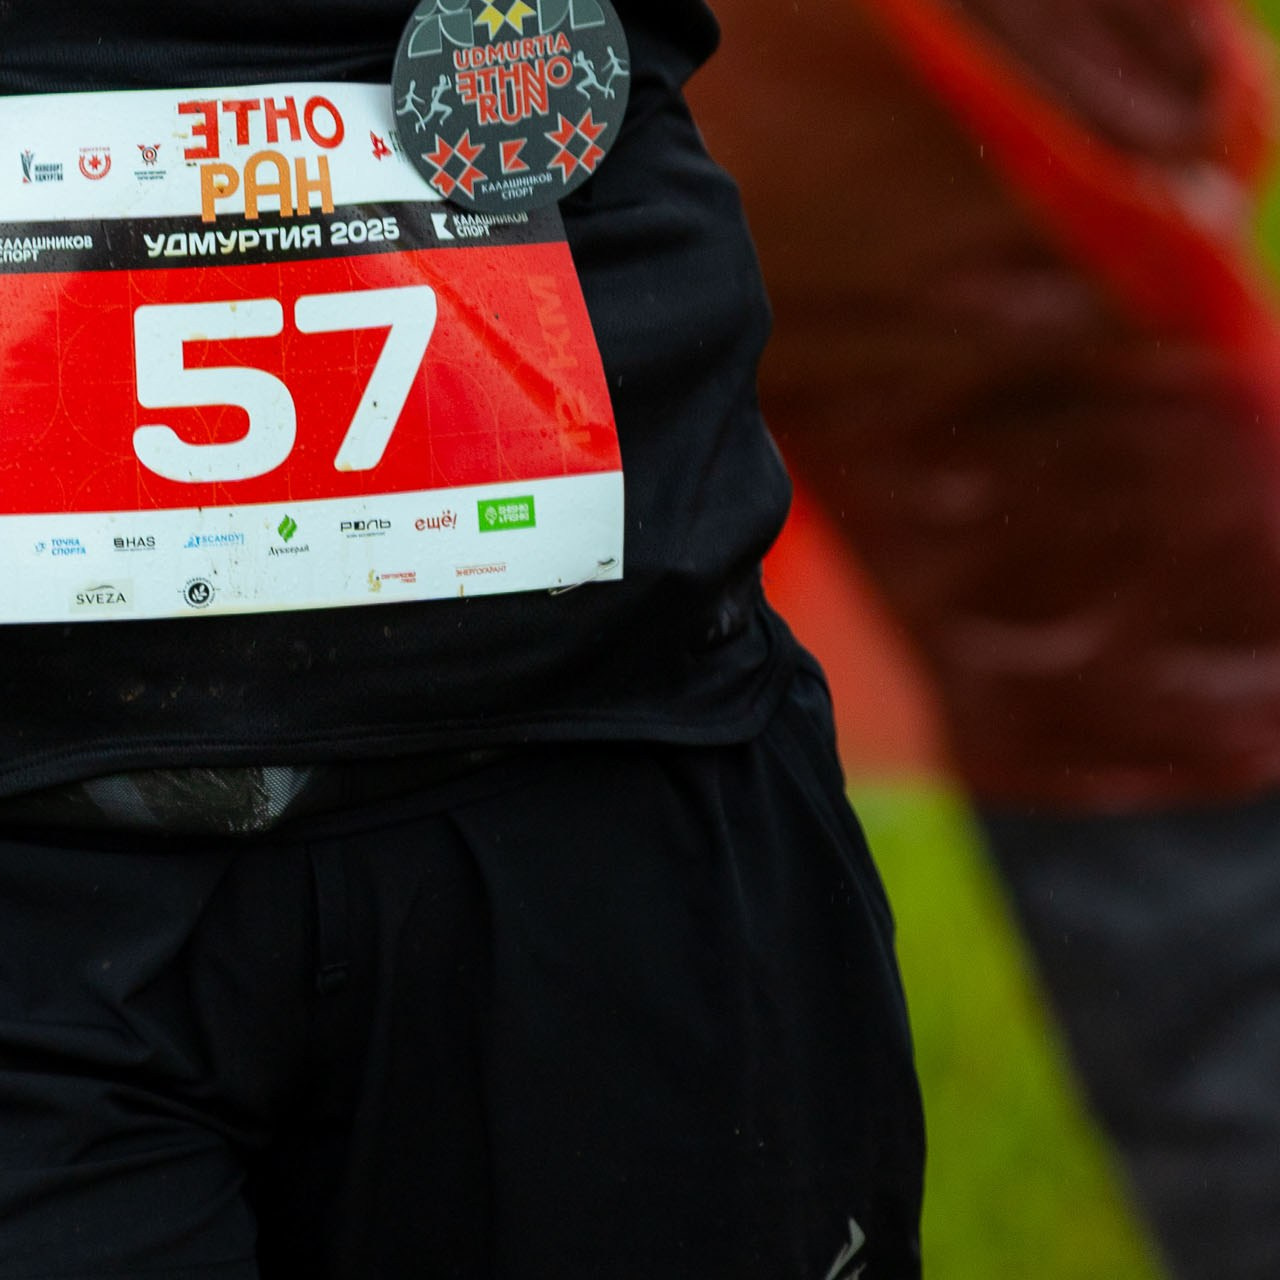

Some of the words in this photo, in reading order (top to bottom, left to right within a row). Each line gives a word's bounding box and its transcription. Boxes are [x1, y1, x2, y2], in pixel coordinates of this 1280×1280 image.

[452, 31, 572, 69] UDMURTIA
[477, 82, 550, 126] RUN
[200, 150, 336, 223] РАН
[480, 172, 554, 195] КАЛАШНИКОВ
[501, 185, 535, 201] СПОРТ
[144, 224, 323, 258] УДМУРТИЯ
[330, 216, 402, 246] 2025
[455, 222, 492, 238] СПОРТ
[131, 284, 438, 486] 57
[75, 591, 128, 606] SVEZA
